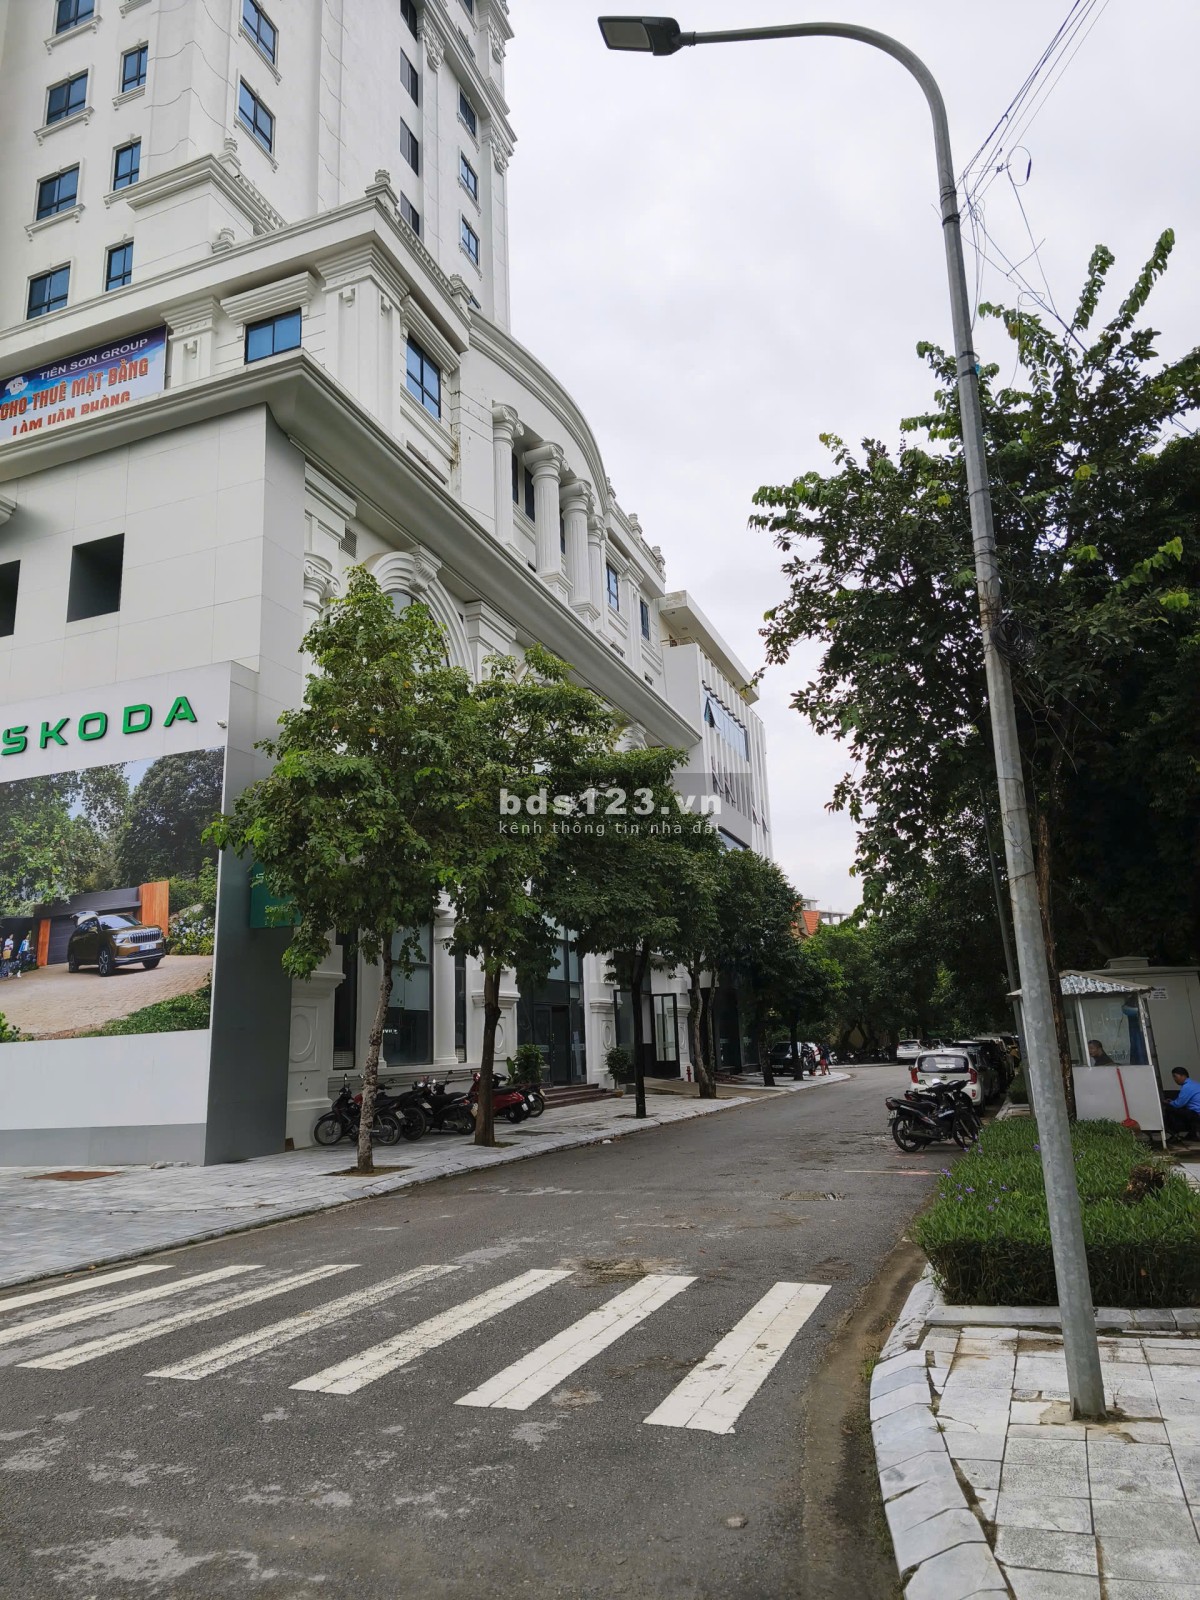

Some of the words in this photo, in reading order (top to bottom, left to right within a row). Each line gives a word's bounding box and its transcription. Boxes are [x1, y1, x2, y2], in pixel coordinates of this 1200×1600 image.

[40, 365, 66, 380] TIÊN
[70, 354, 98, 370] SƠN
[101, 338, 148, 360] GROUP
[0, 396, 28, 421] CHO
[32, 380, 67, 411] THUÊ
